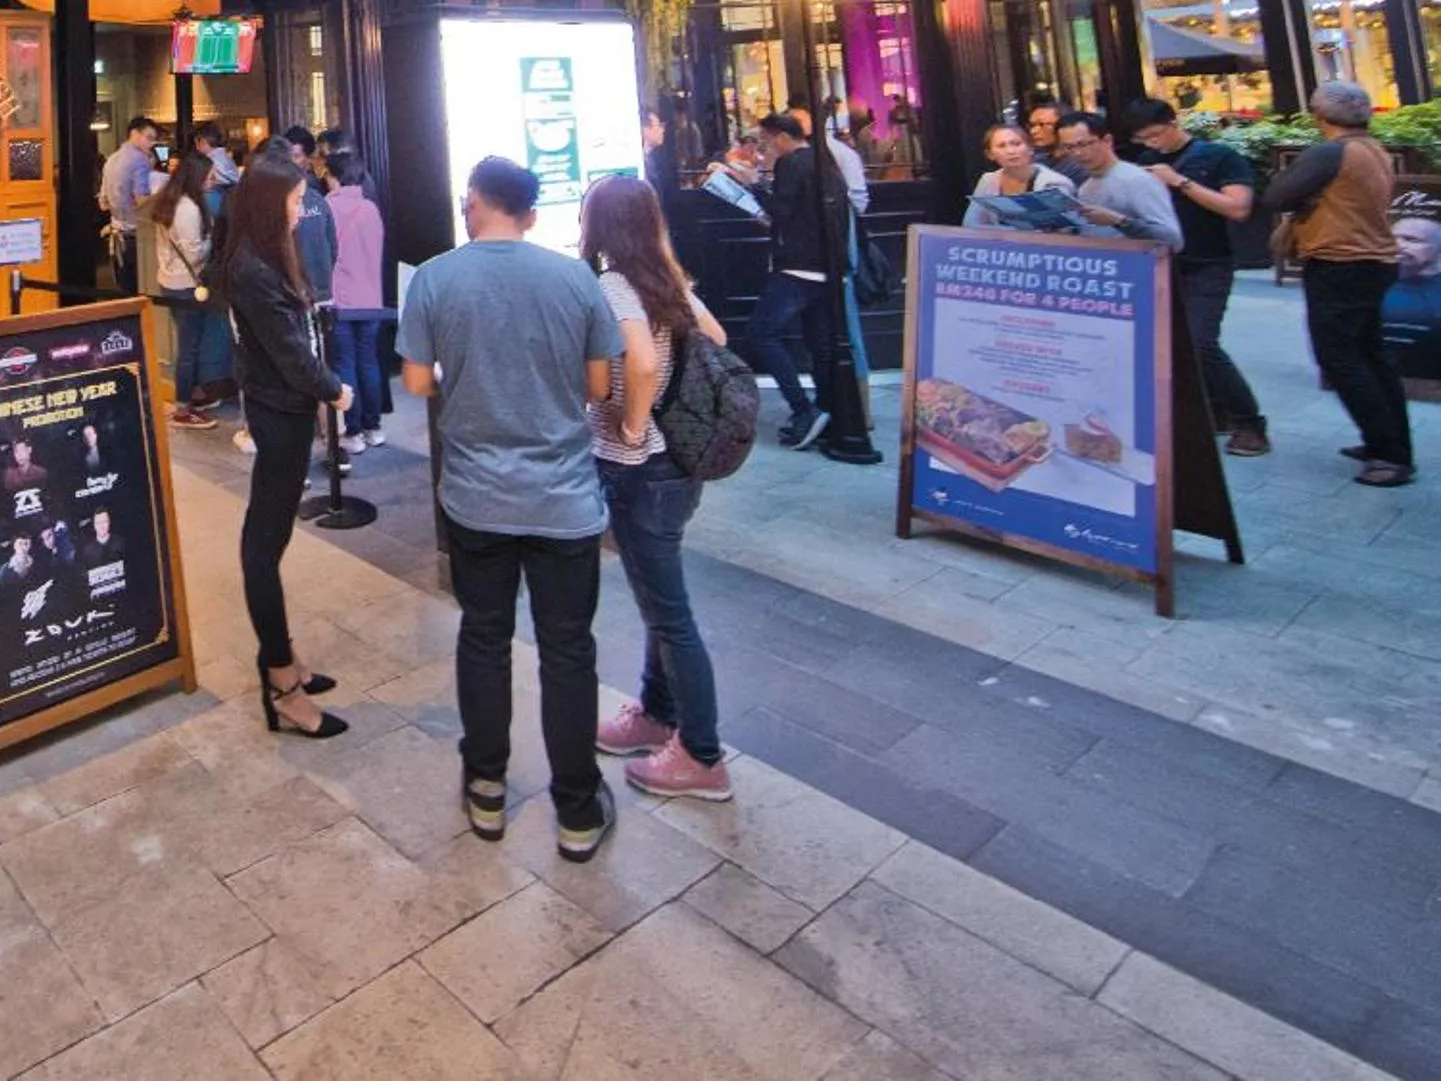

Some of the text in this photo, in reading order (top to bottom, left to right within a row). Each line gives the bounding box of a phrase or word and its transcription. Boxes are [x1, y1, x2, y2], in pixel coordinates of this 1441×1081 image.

[948, 246, 1119, 277] SCRUMPTIOUS
[936, 263, 1134, 299] WEEKEND ROAST
[999, 290, 1037, 306] FOR
[1058, 297, 1135, 317] PEOPLE
[46, 388, 79, 409] NEW
[80, 381, 118, 402] YEAR
